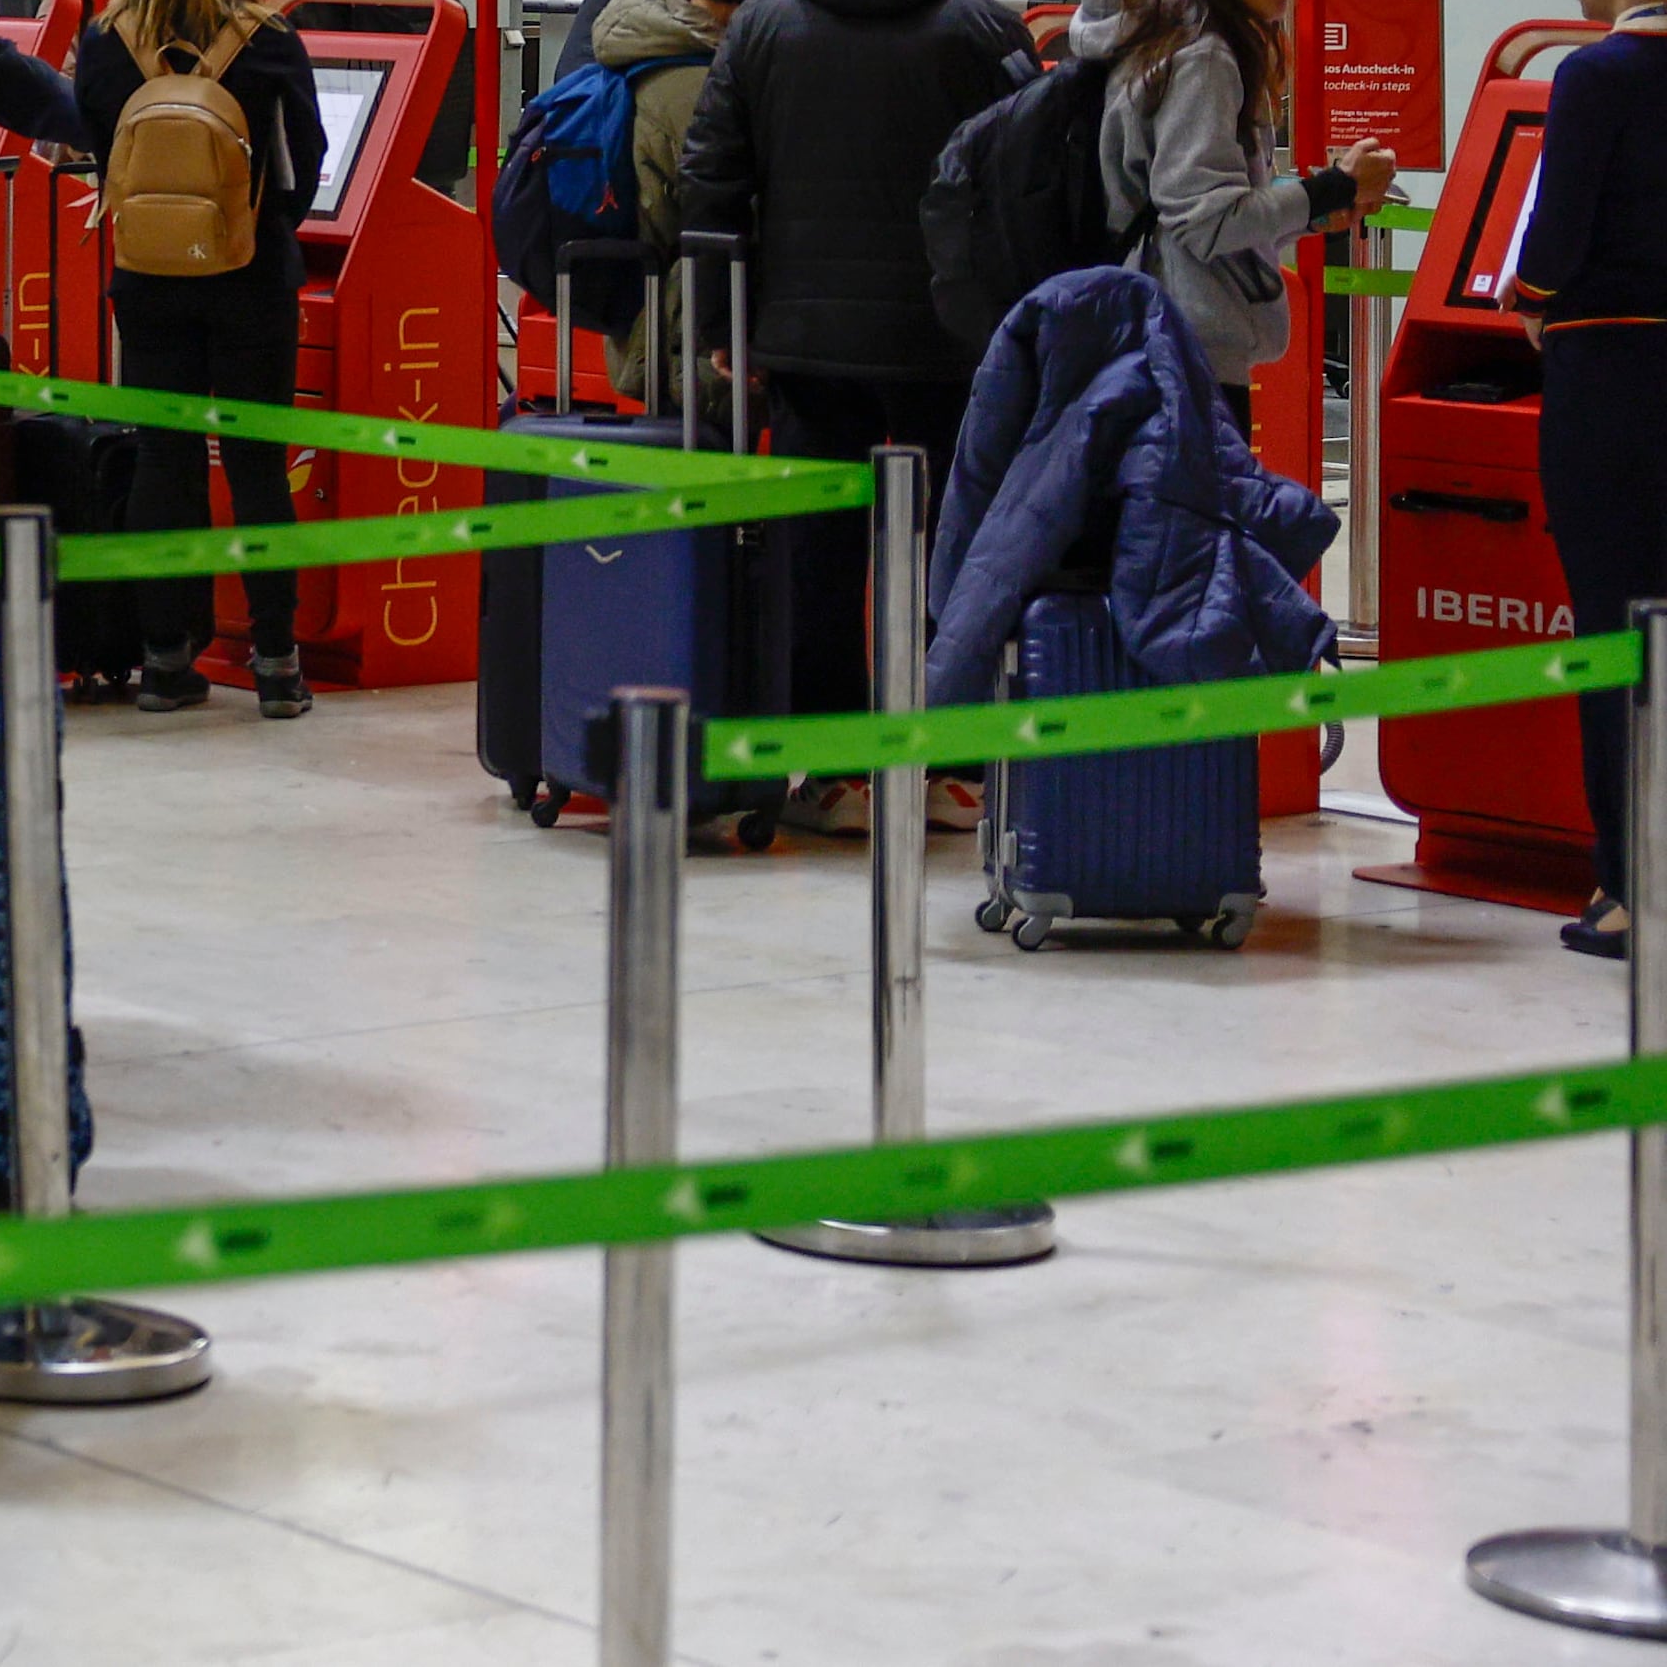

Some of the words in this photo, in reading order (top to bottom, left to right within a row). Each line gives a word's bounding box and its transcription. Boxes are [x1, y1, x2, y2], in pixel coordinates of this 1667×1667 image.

[1342, 63, 1415, 75] Autocheck-in
[1324, 80, 1380, 91] tocheck-in
[1381, 82, 1411, 93] steps
[1417, 586, 1576, 639] IBERIA
